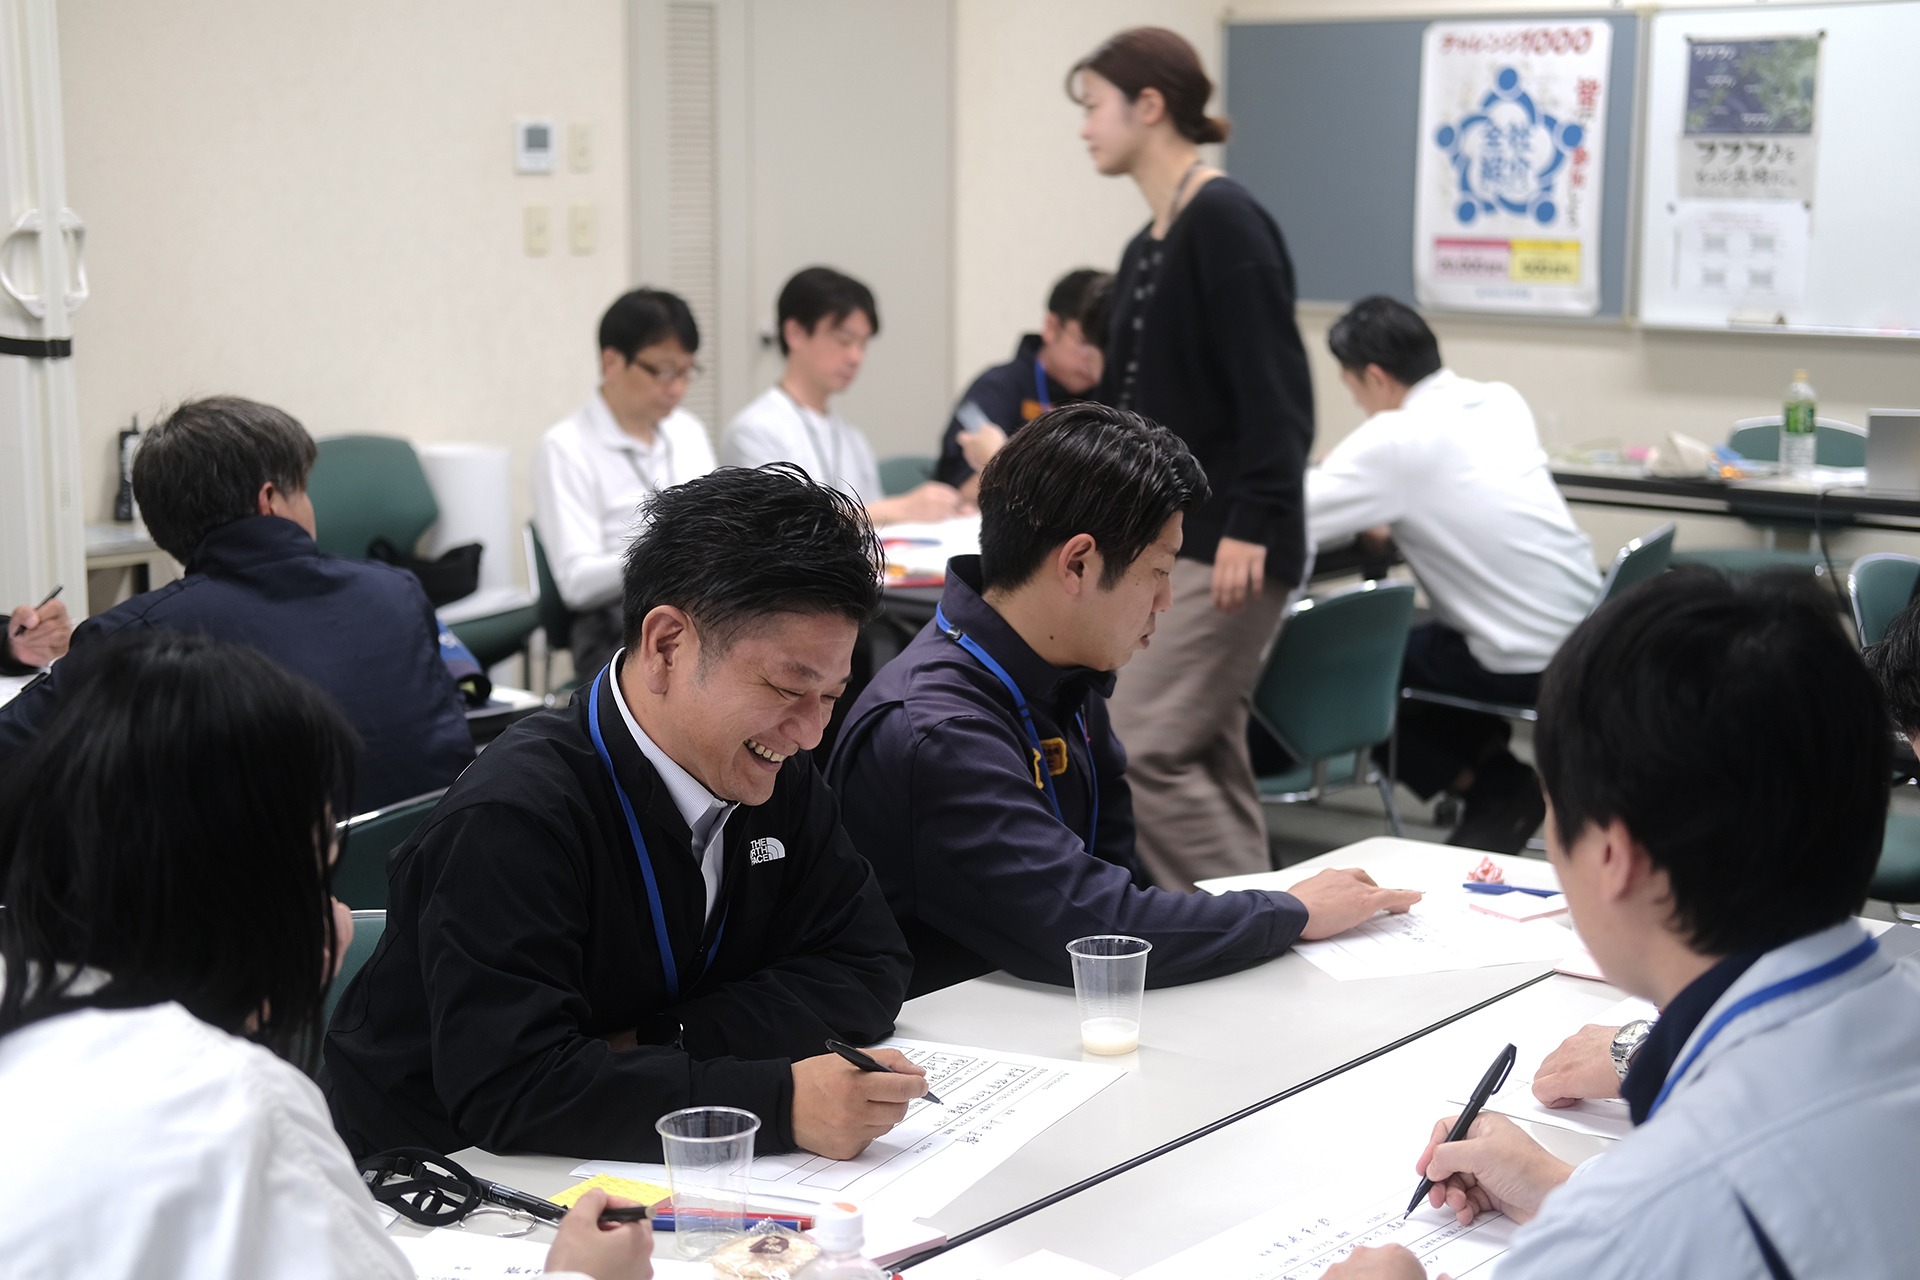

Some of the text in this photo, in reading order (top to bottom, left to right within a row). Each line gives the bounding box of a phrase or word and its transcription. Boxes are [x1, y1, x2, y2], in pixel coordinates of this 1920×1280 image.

[1441, 28, 1593, 56] チャレンジ1000
[750, 838, 767, 849] THE
